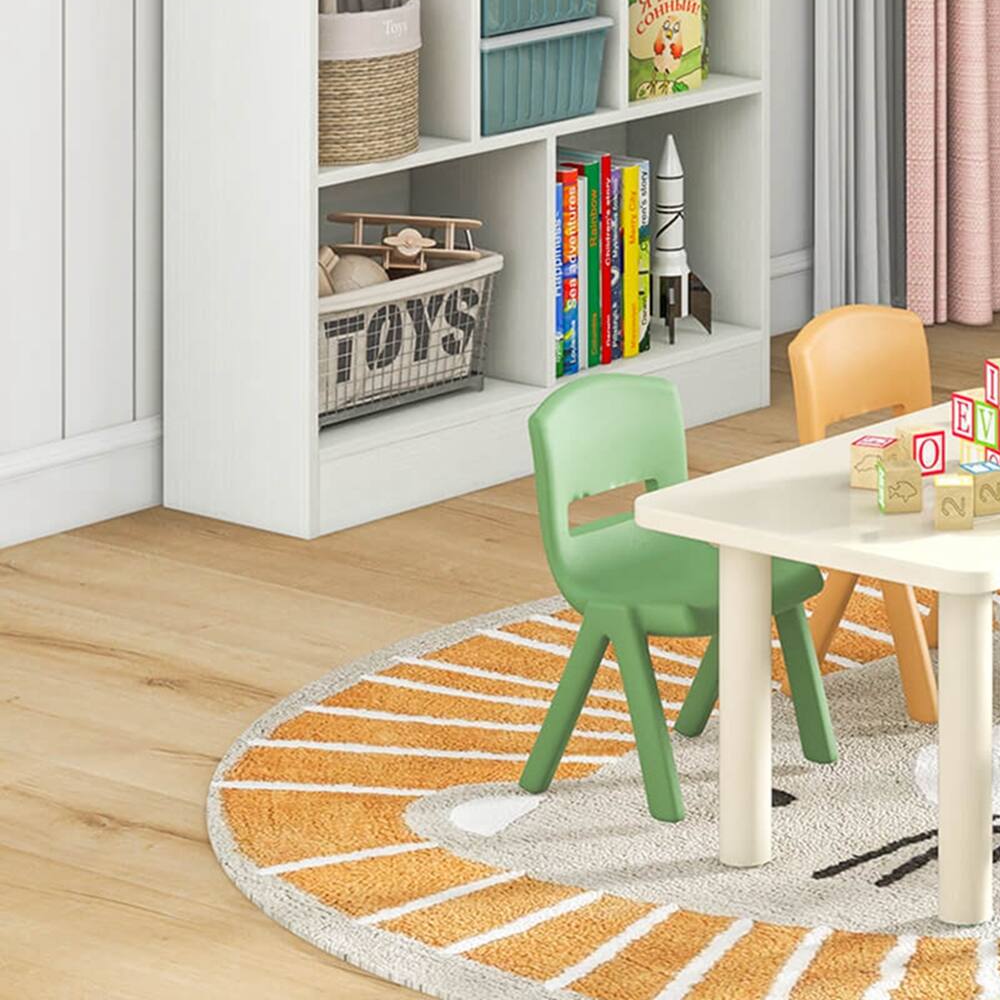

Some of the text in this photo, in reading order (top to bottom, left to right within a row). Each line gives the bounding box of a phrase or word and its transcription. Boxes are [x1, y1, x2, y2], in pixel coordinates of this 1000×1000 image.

[640, 170, 648, 198] story
[566, 186, 577, 275] adventures
[589, 188, 598, 247] Rainbow
[568, 278, 577, 309] Sea
[324, 287, 479, 384] TOYS
